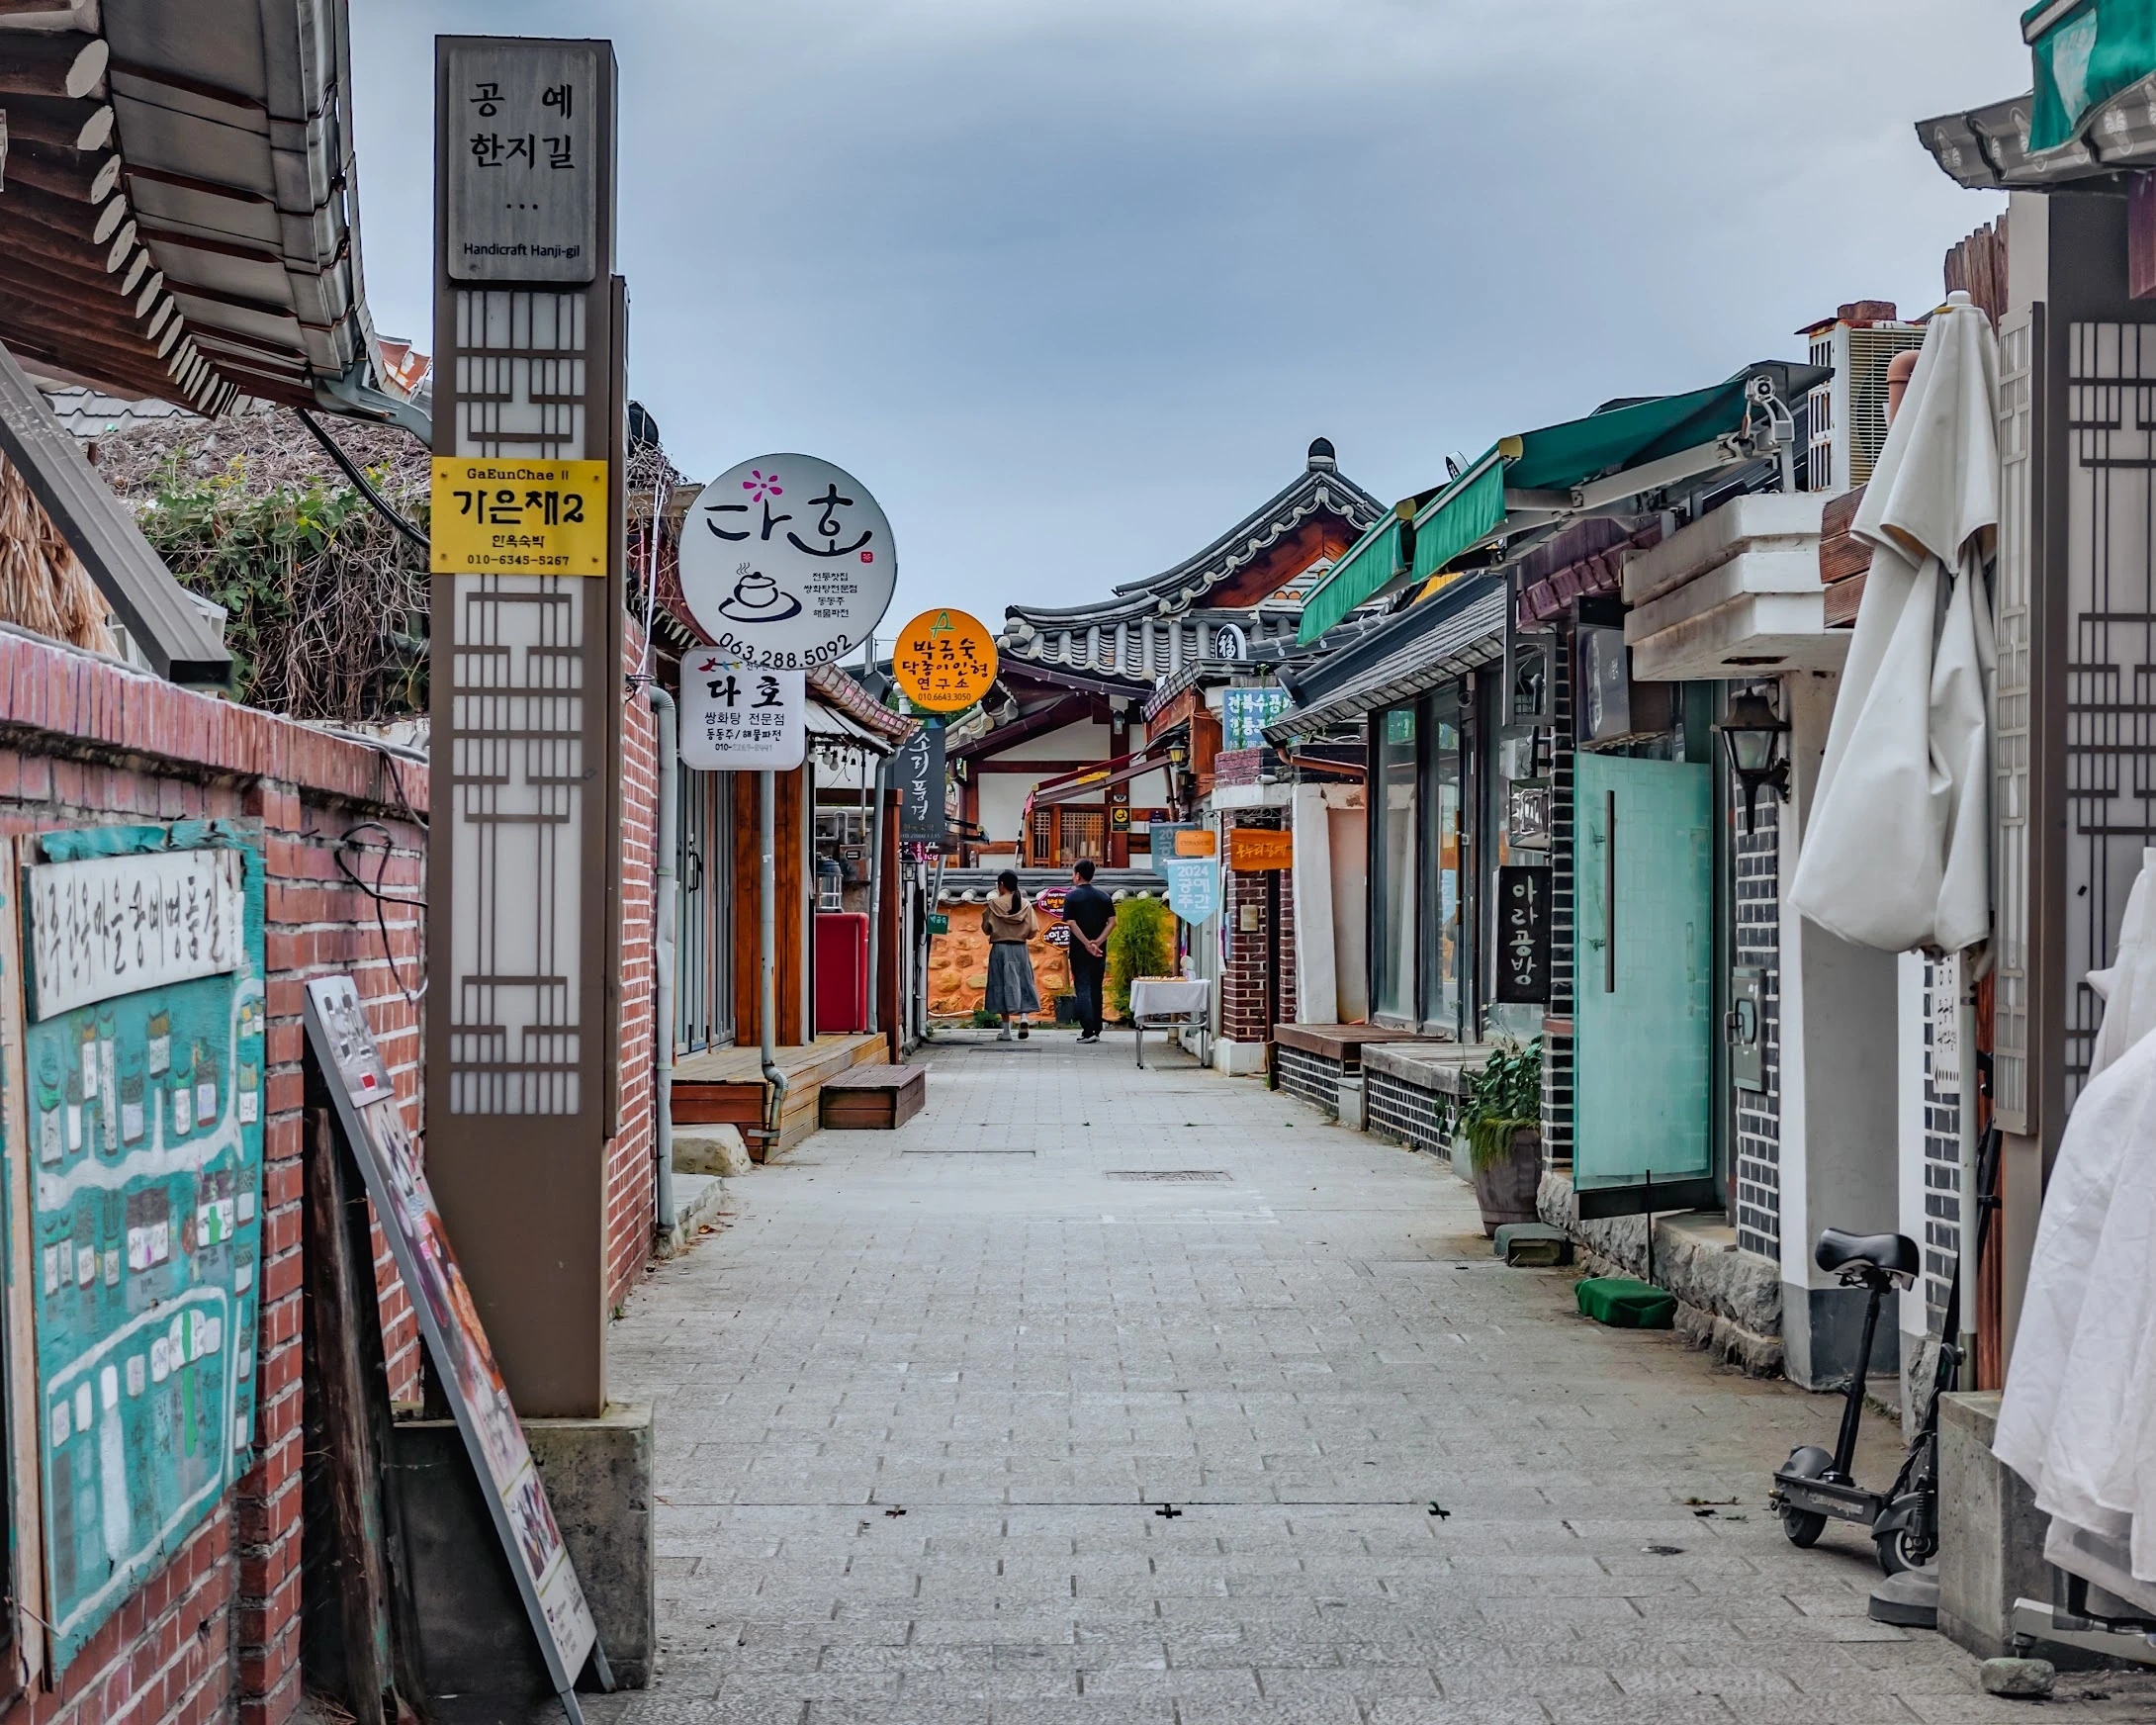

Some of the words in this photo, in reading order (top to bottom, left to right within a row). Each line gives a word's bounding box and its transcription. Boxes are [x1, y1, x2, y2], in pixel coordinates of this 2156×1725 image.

[470, 133, 576, 169] 한지길
[463, 242, 528, 256] Handicraft
[530, 243, 581, 259] Hanji-gil
[467, 468, 554, 481] GaEunChae
[453, 490, 584, 525] 가은채2
[492, 534, 545, 548] 한옥숙박
[467, 554, 570, 566] 010-6345-5267
[817, 596, 845, 606] 동동주
[812, 608, 850, 618] 해물파전
[719, 633, 853, 670] 063.288.5092
[913, 638, 976, 661] 박금숙
[902, 660, 989, 678] 닥종이인형
[706, 675, 784, 708] 다호
[917, 678, 969, 690] 연구소
[704, 712, 741, 725] 쌍화탕
[748, 712, 784, 726] 전문점
[908, 732, 932, 821] 소리풍경
[1177, 865, 1209, 877] 2024
[1178, 878, 1211, 894] 공예
[1178, 894, 1211, 909] 주간
[1508, 874, 1539, 985] 아라공방
